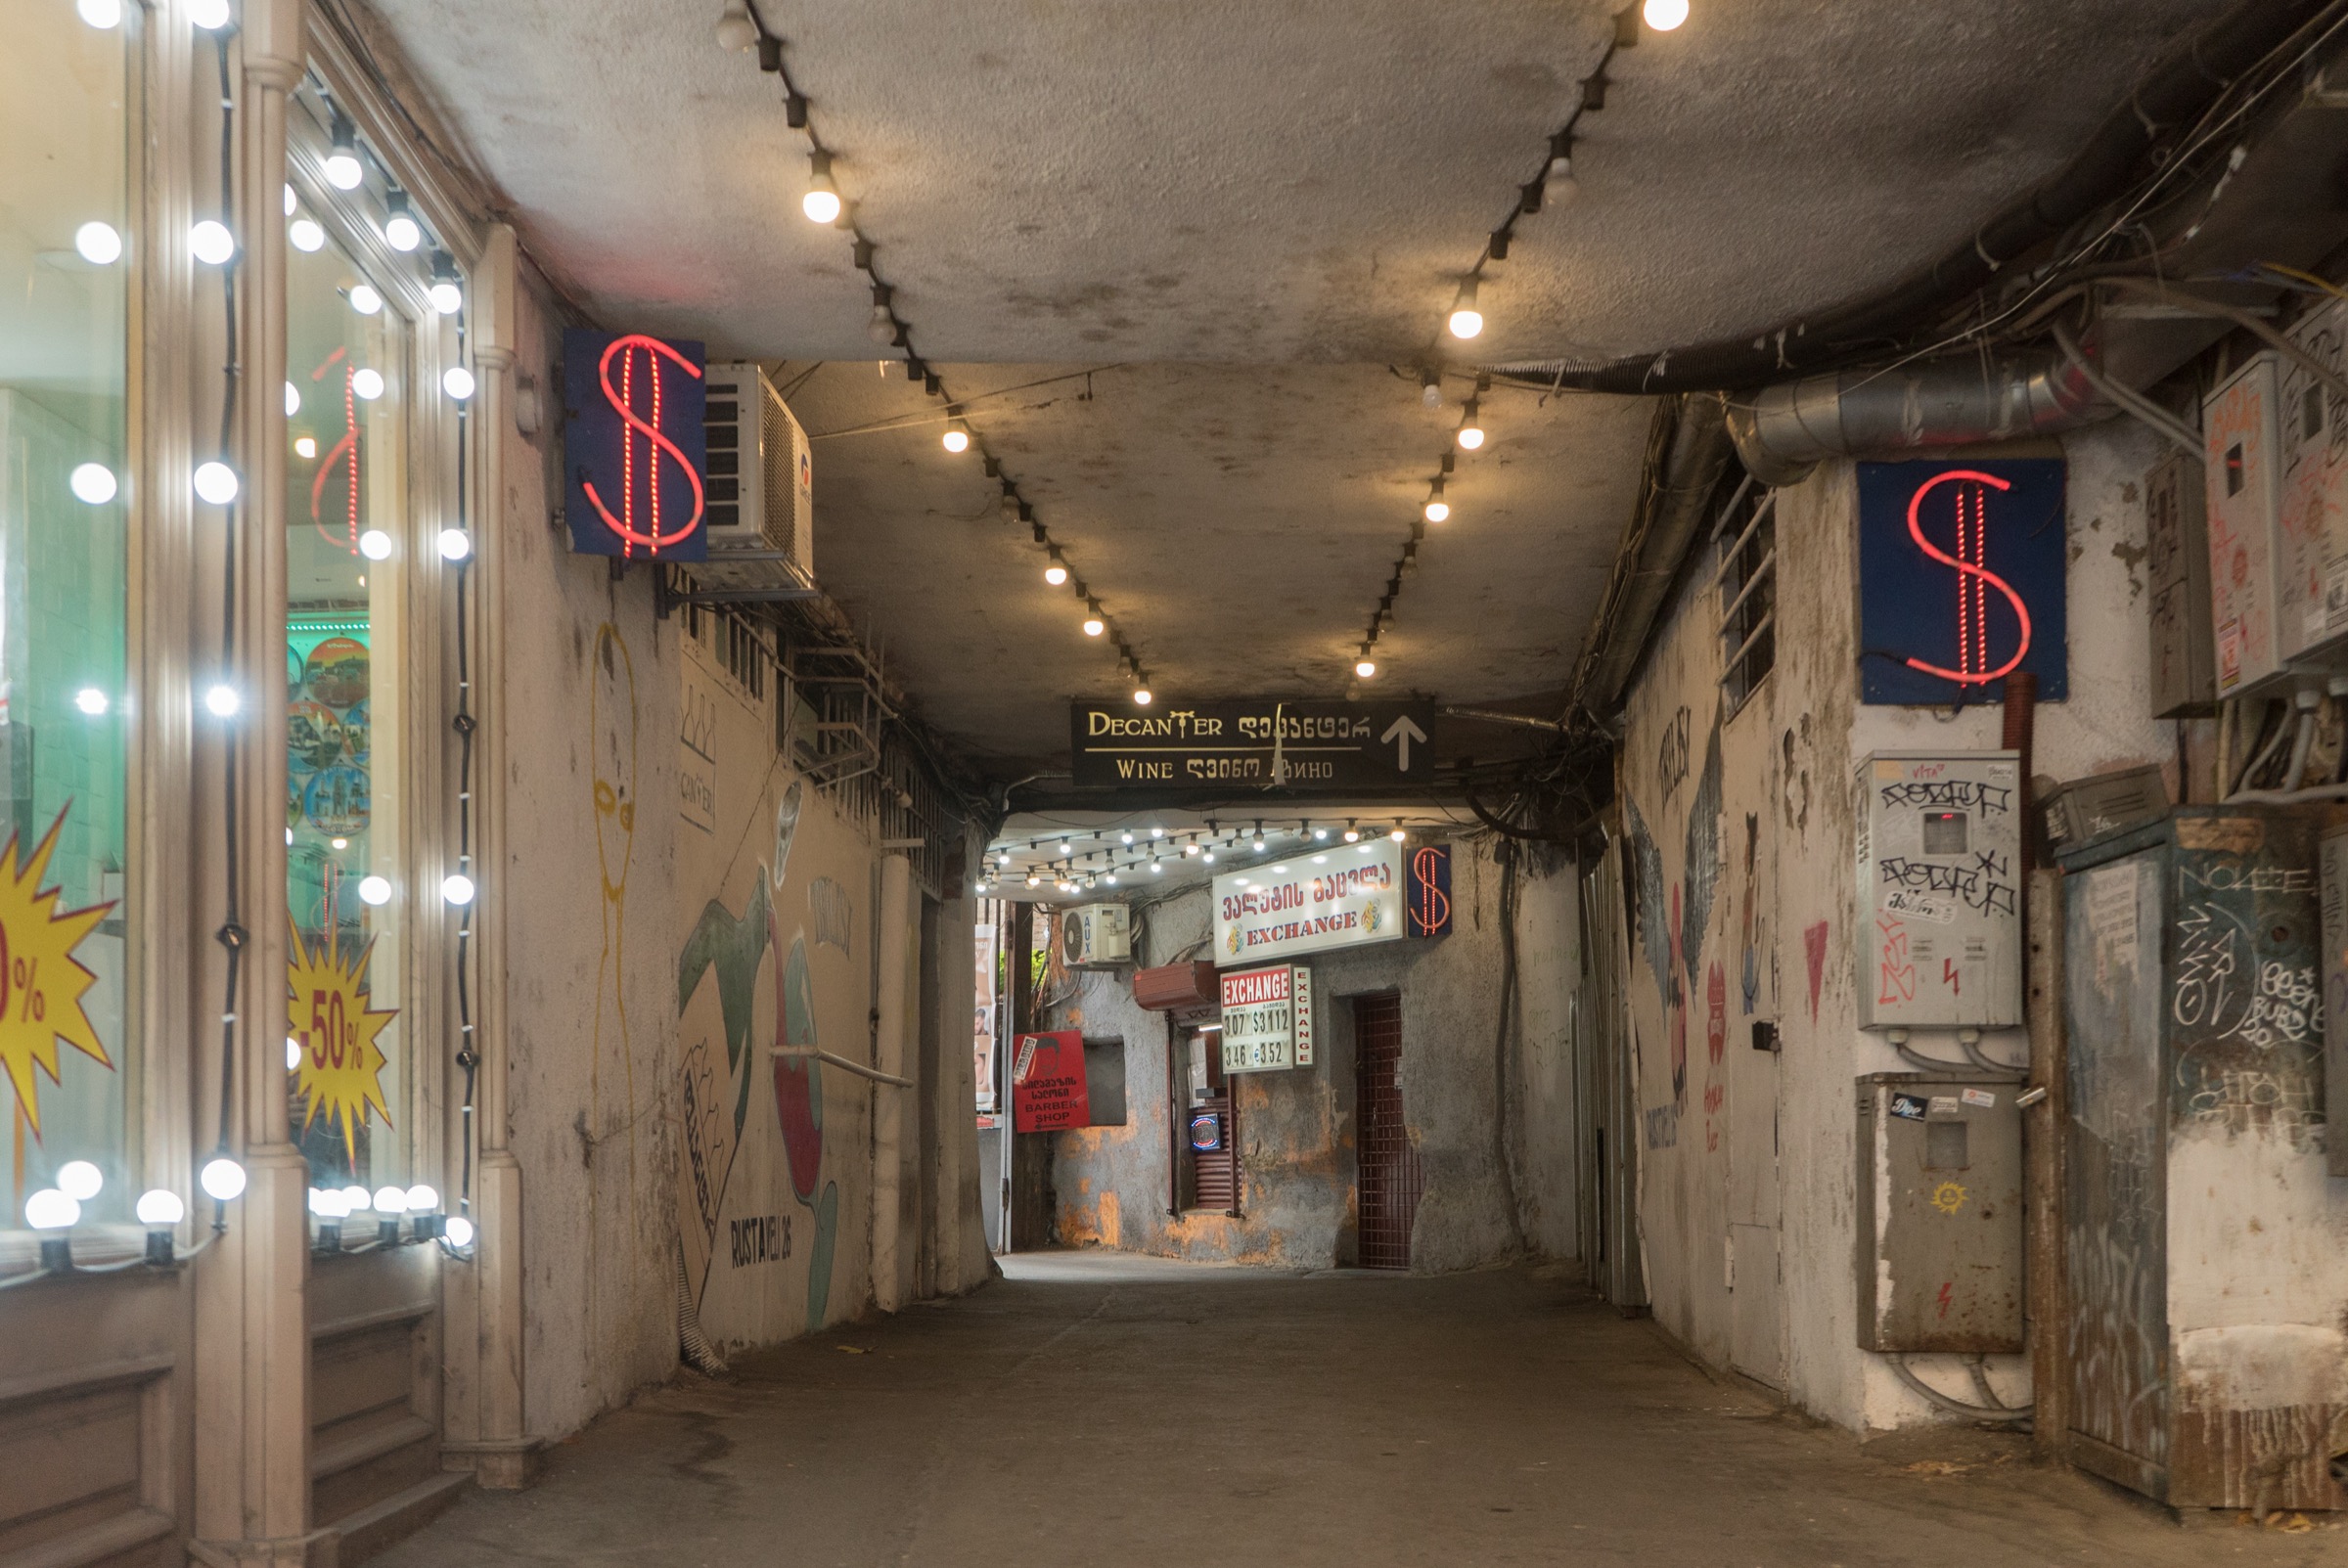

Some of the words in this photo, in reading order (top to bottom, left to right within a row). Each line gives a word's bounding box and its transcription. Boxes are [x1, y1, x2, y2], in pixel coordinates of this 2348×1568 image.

[1088, 710, 1223, 739] DECANTER
[1116, 759, 1174, 780] WINE
[1187, 758, 1260, 779] ღვინო
[1223, 882, 1304, 920] ვალუტის
[1313, 862, 1391, 903] გაცვლა
[1246, 911, 1358, 946] EXCHANGE
[1223, 972, 1288, 1005] EXCHANGE
[299, 989, 364, 1071] -50%
[1297, 971, 1310, 1062] EXCHANGE
[1025, 1100, 1078, 1113] BARBER
[1035, 1112, 1070, 1123] SHOP
[730, 1215, 780, 1270] RUSTAVELI
[782, 1214, 791, 1260] 26
